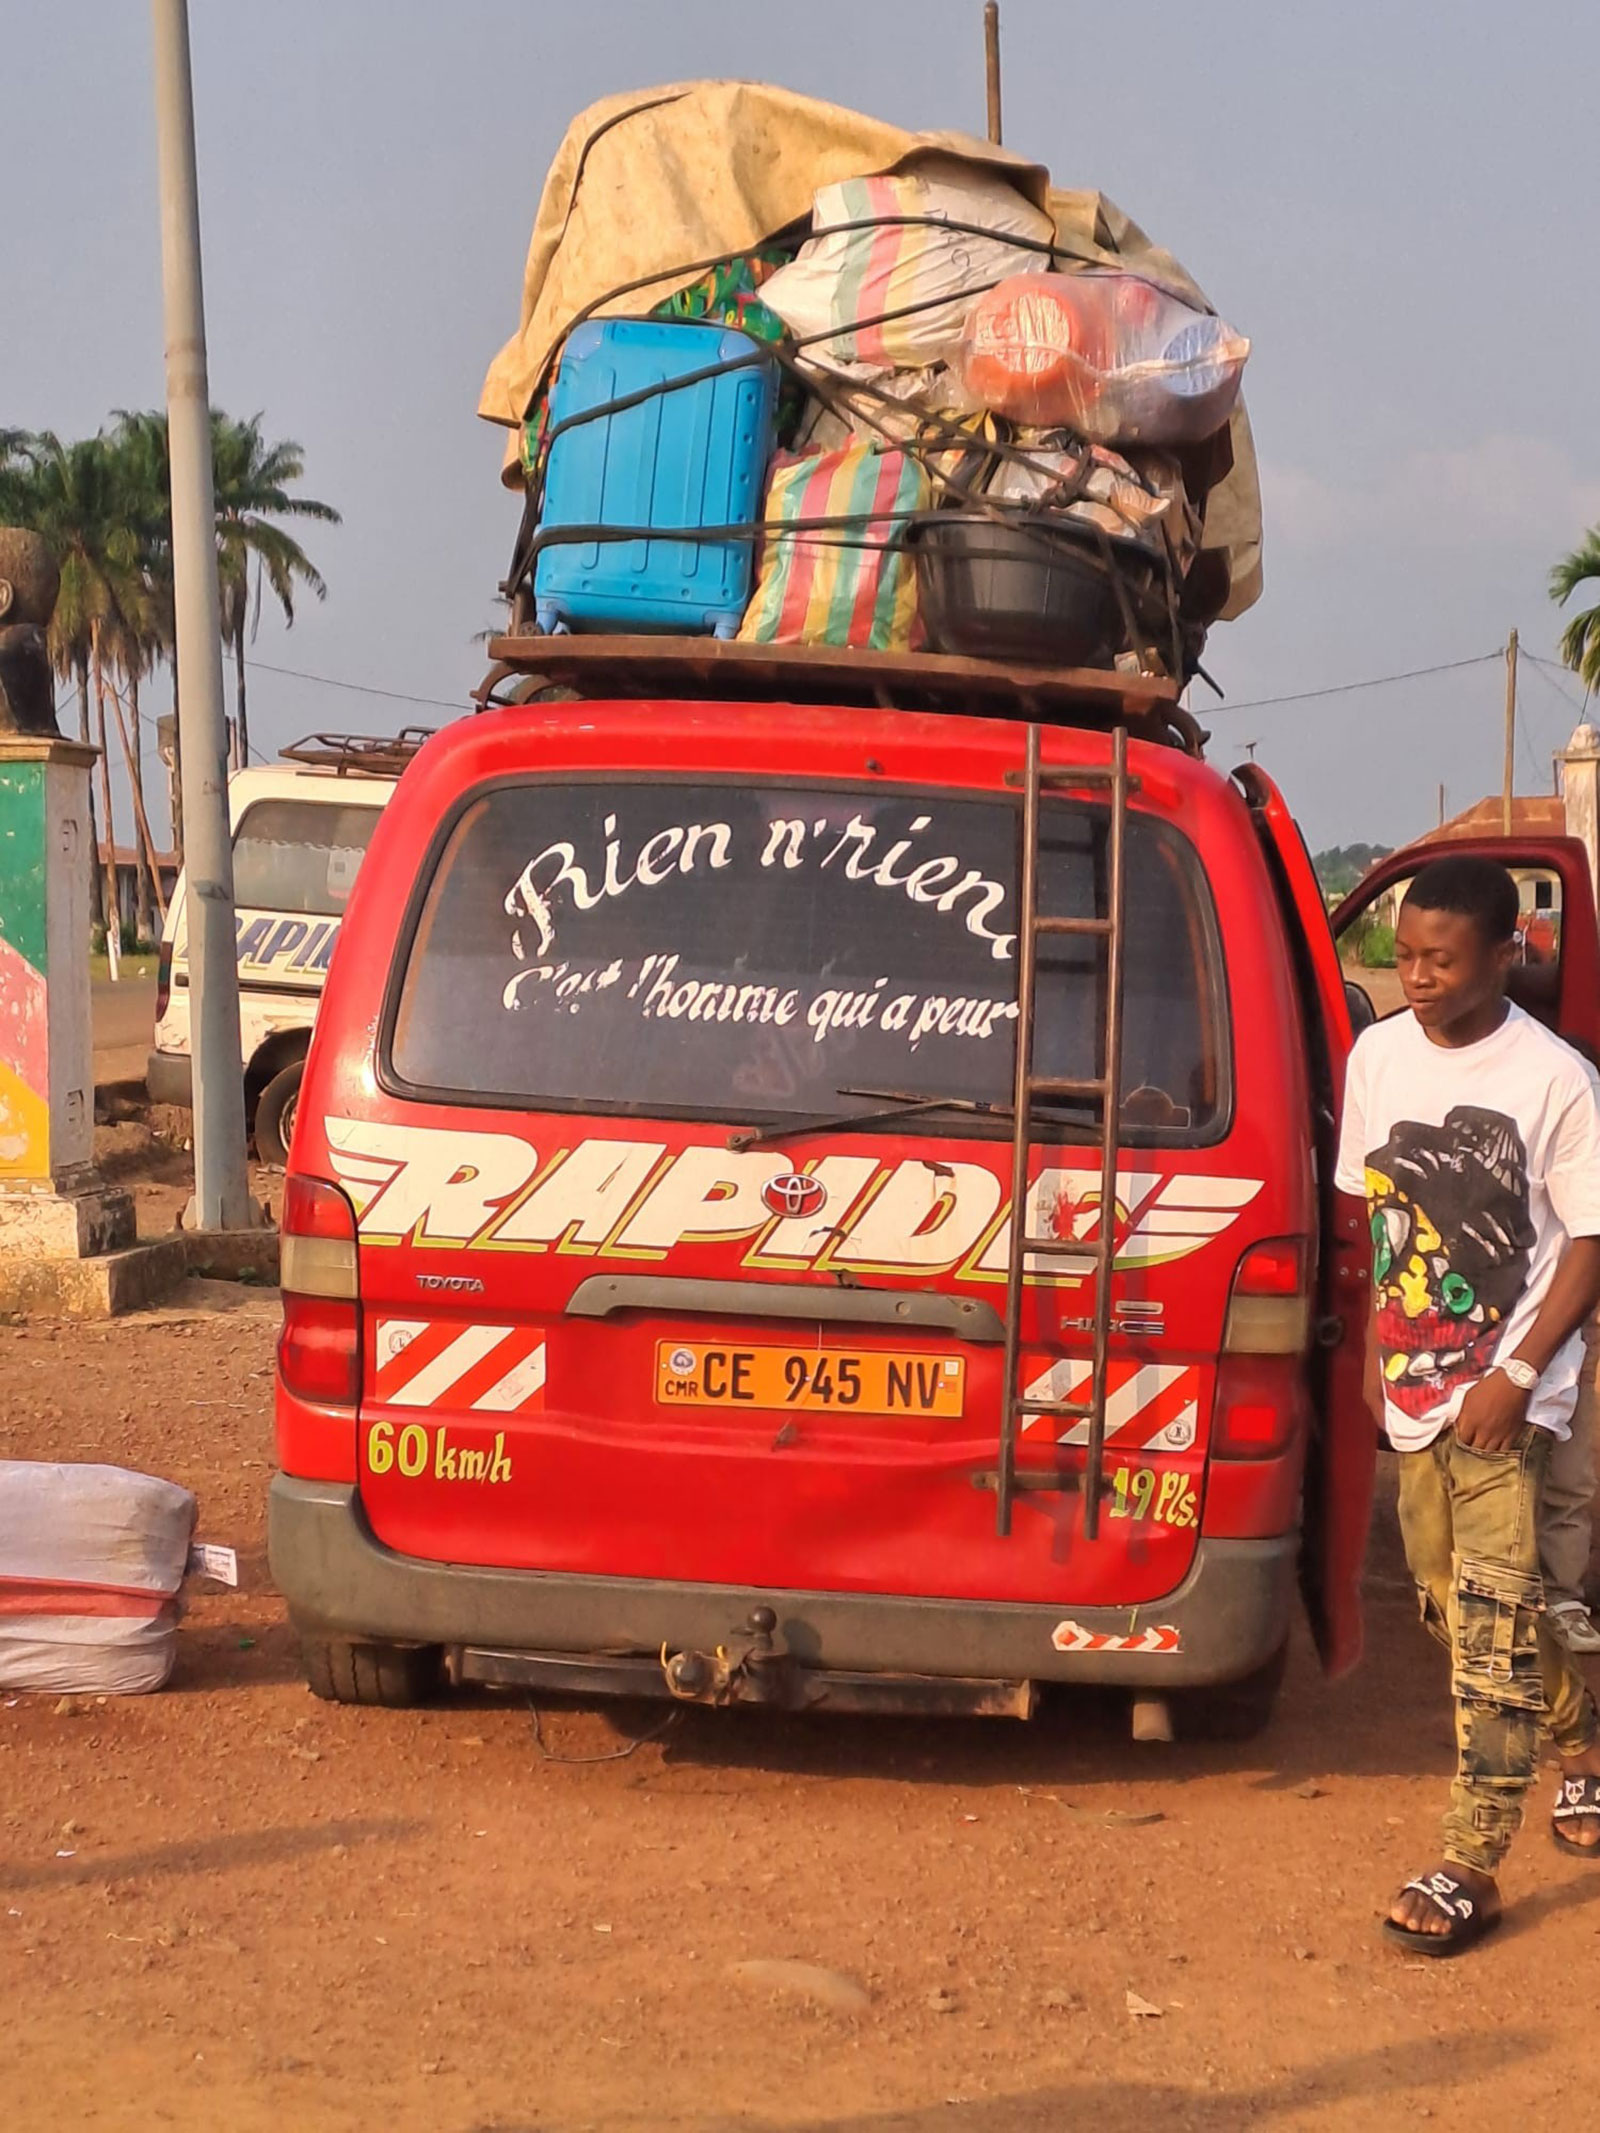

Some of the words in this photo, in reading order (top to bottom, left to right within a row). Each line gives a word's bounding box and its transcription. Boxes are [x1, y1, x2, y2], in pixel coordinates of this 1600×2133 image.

[503, 813, 733, 961] Rien
[806, 976, 889, 1043] qui
[879, 994, 918, 1031] a
[907, 995, 1020, 1053] peur
[415, 1273, 486, 1292] TOYOTA
[664, 1379, 699, 1398] CMR
[702, 1351, 756, 1401] CE
[784, 1355, 862, 1405] 945
[886, 1359, 941, 1409] NV
[367, 1420, 429, 1478] 60
[434, 1425, 513, 1486] km/h
[1108, 1466, 1157, 1521] 19
